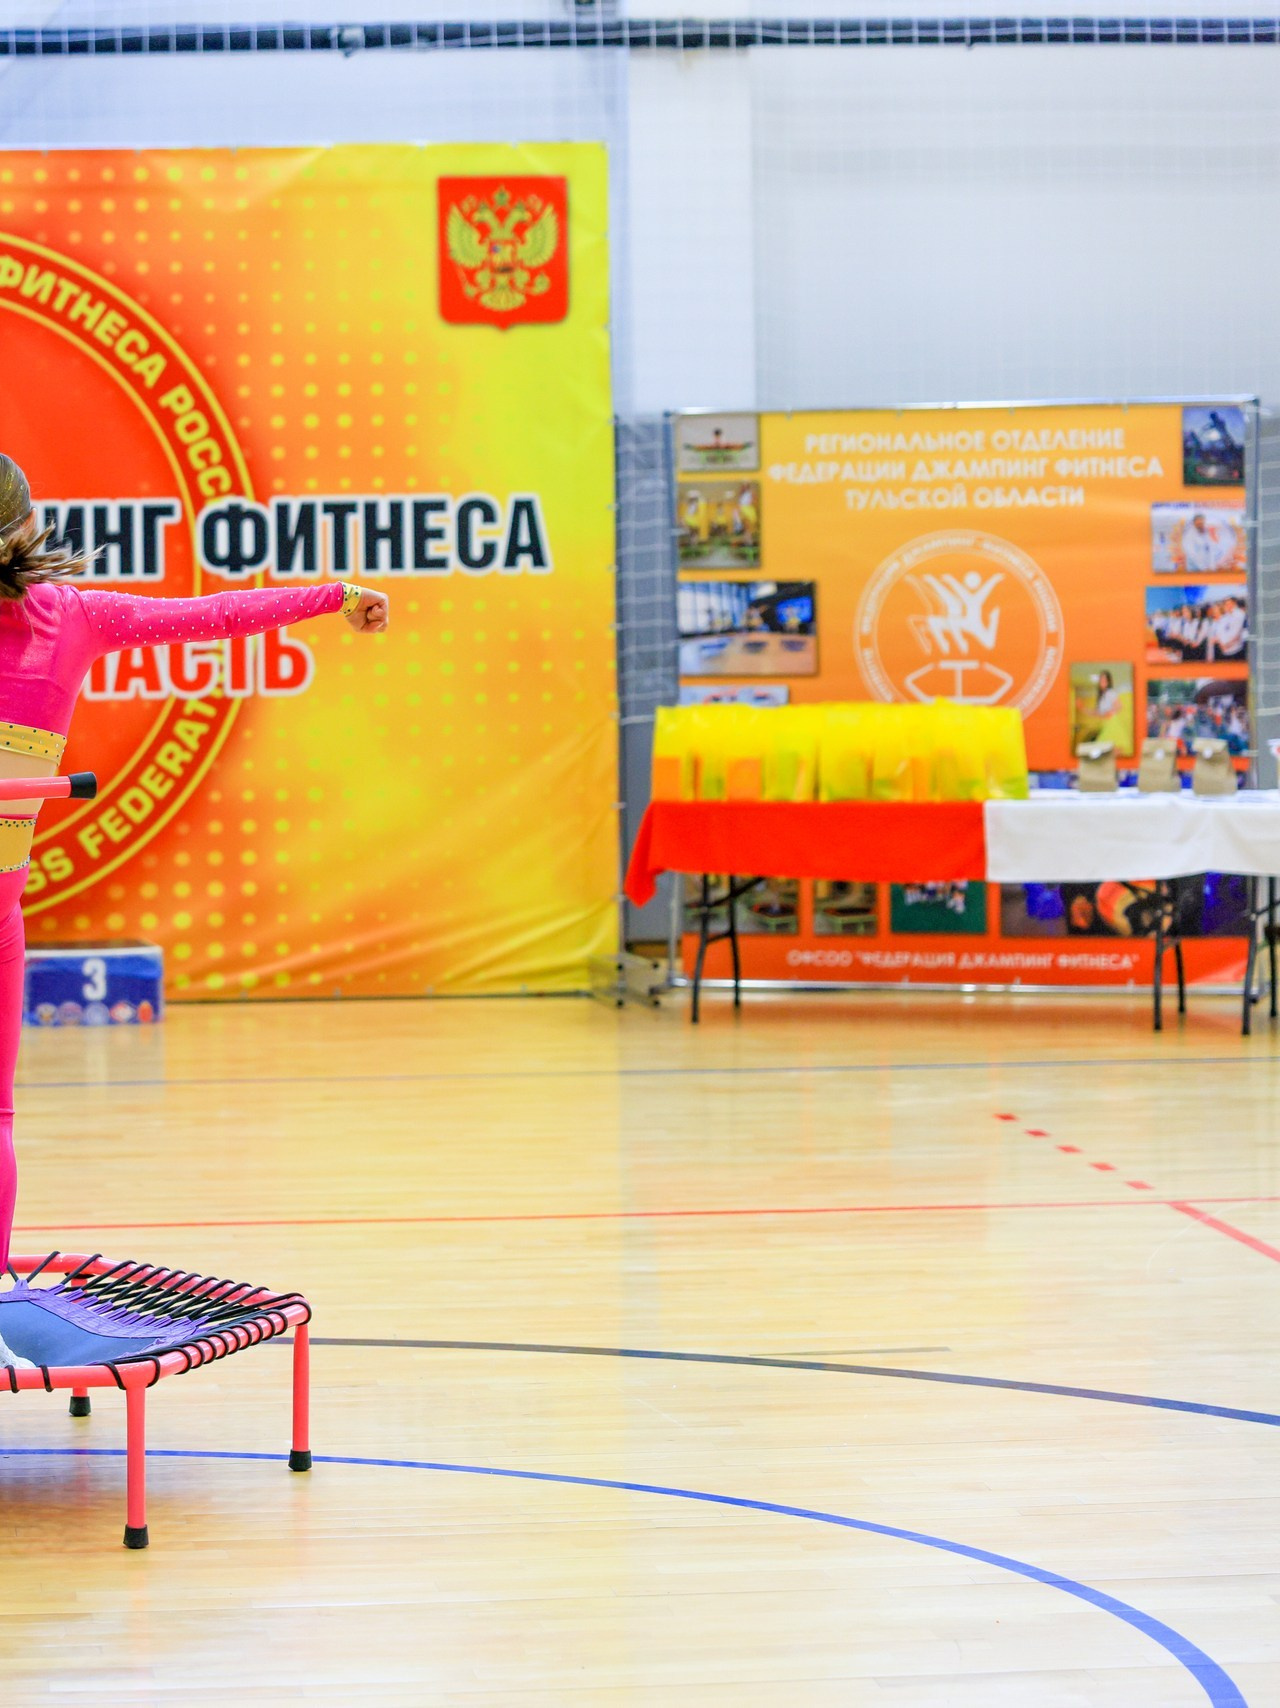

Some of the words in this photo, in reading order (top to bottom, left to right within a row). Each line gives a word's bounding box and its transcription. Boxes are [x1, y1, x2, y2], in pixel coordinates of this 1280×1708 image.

[158, 384, 232, 500] РОСС
[804, 430, 986, 454] РЕГИОНАЛЬНОЕ
[990, 428, 1125, 452] ОТДЕЛЕНИЕ
[911, 457, 1050, 482] ДЖАМПИНГ
[1054, 455, 1164, 479] ФИТНЕСА
[845, 482, 969, 512] ТУЛЬСКОЙ
[973, 485, 1085, 510] ОБЛАСТИ
[196, 492, 553, 579] ФИТНЕСА
[77, 697, 217, 860] FEDERAT
[81, 957, 108, 1001] 3
